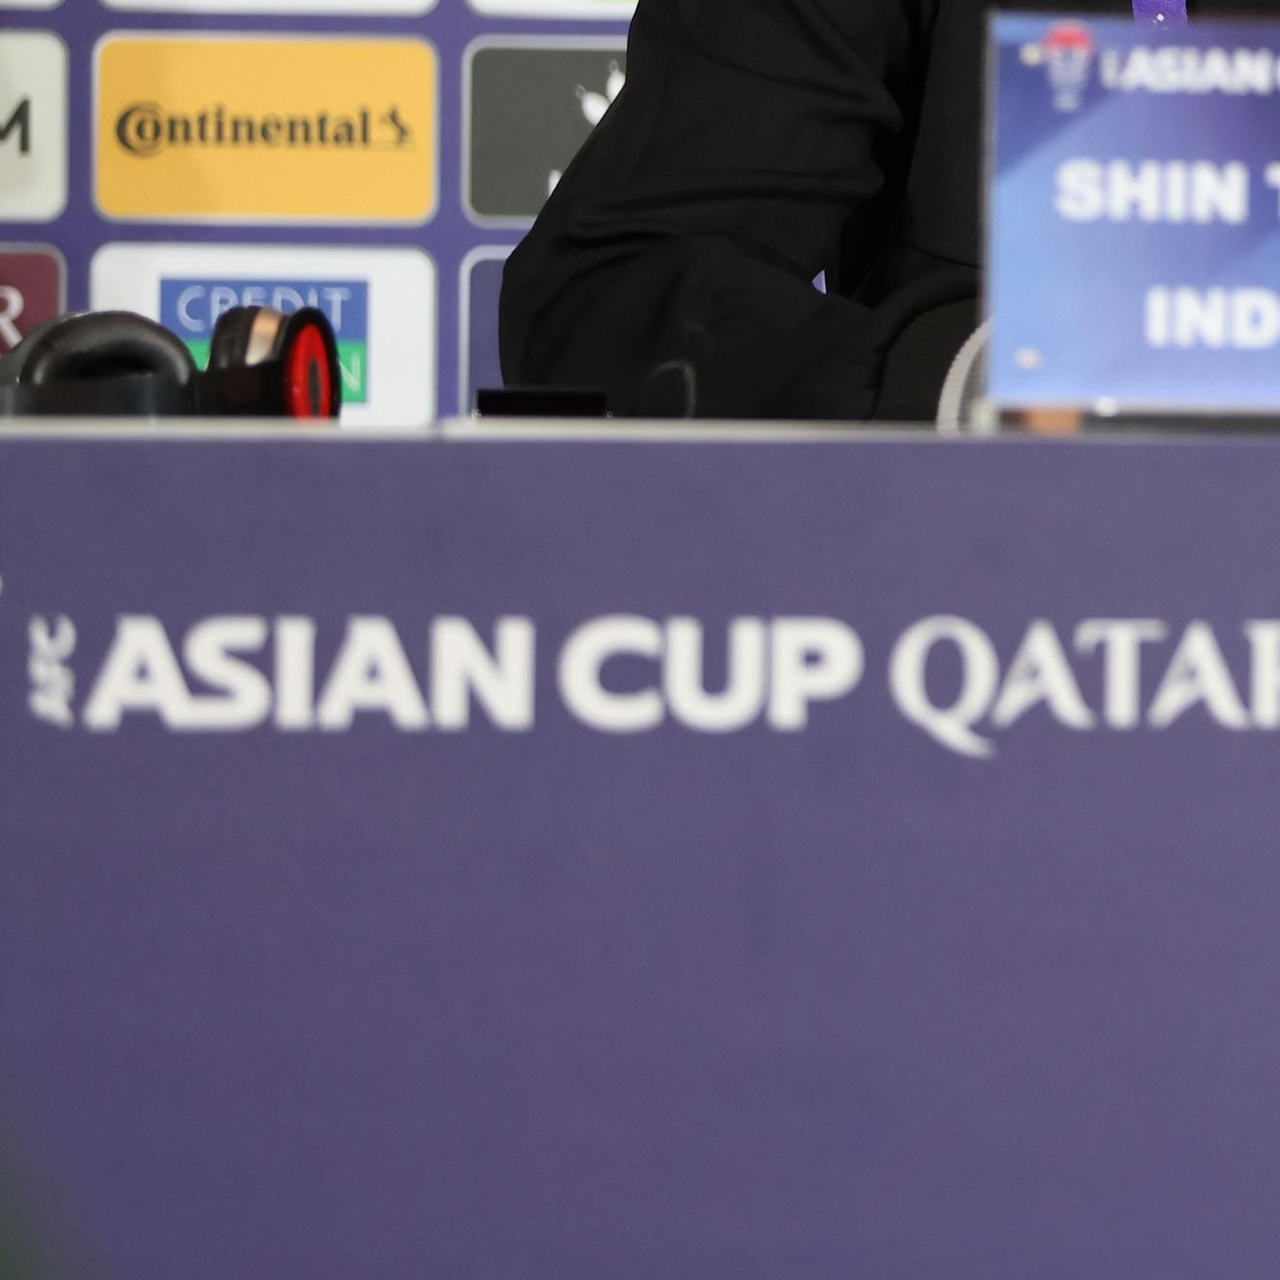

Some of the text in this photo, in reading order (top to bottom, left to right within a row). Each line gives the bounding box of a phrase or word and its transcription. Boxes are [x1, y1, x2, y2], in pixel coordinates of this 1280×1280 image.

[1122, 46, 1274, 96] ASIAN
[114, 101, 372, 159] Continental
[1052, 157, 1251, 225] SHIN
[82, 613, 537, 733] ASIAN
[557, 613, 865, 733] CUP
